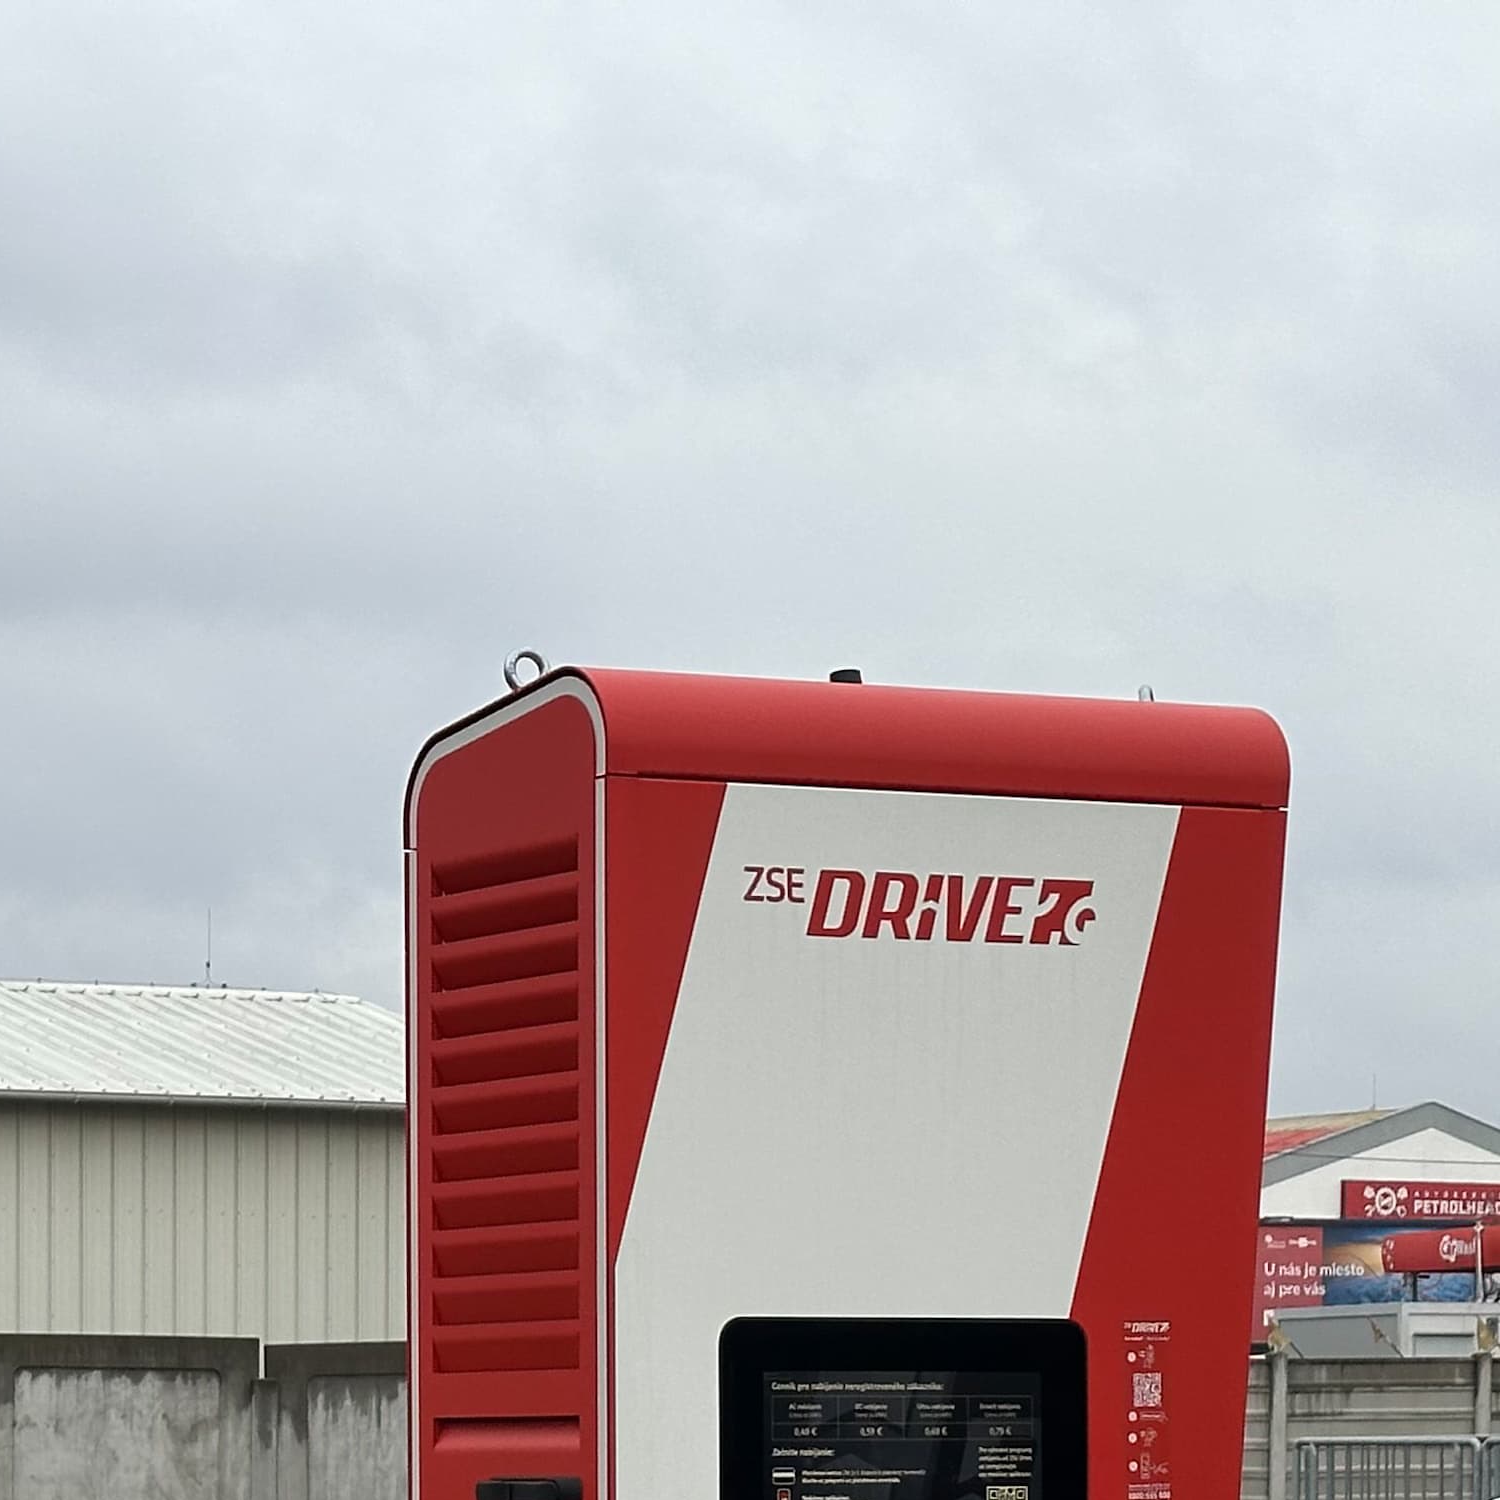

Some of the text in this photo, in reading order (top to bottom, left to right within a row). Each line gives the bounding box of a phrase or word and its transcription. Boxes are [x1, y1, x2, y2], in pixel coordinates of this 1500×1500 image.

[743, 866, 1035, 944] ZSE DRIVE
[1264, 1262, 1365, 1280] U nás je miesto
[1263, 1281, 1326, 1298] aj pre vás
